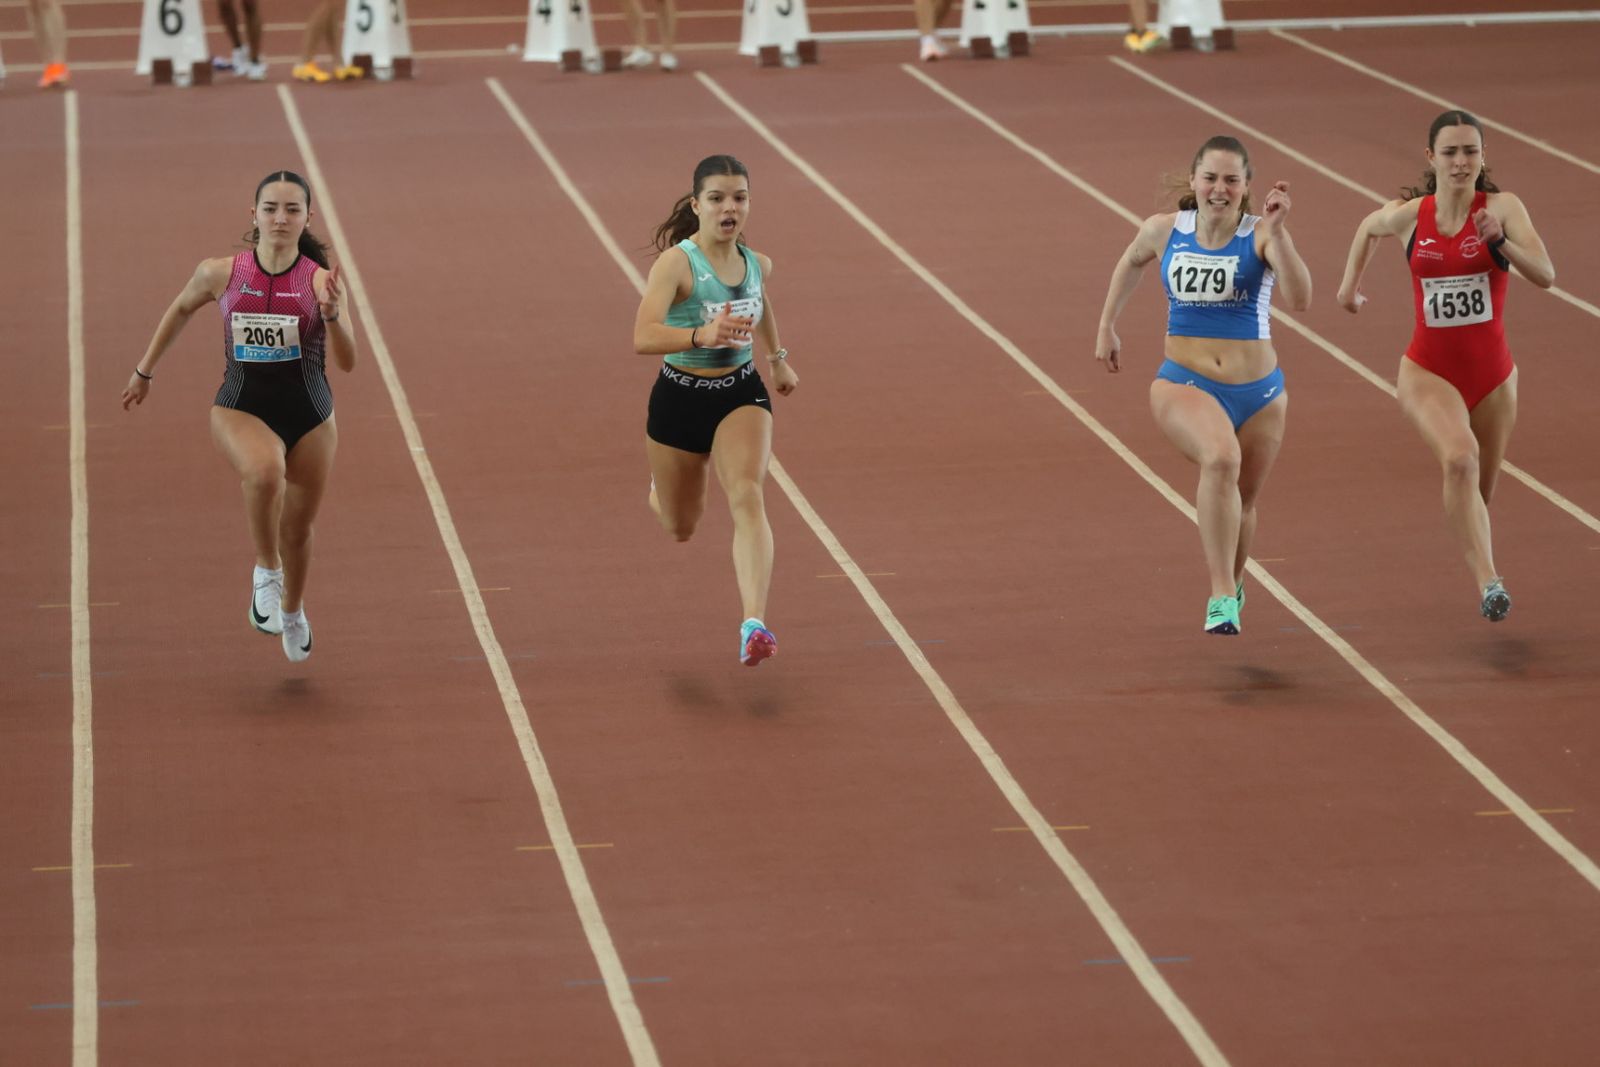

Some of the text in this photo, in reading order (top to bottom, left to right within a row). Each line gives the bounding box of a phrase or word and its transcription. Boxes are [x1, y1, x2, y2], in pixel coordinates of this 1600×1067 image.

[159, 0, 183, 36] 6
[356, 0, 374, 33] 5
[1172, 266, 1226, 294] 1279
[1428, 289, 1486, 319] 1538
[243, 326, 285, 347] 2061
[662, 364, 694, 387] NIKE
[694, 376, 736, 390] PRO
